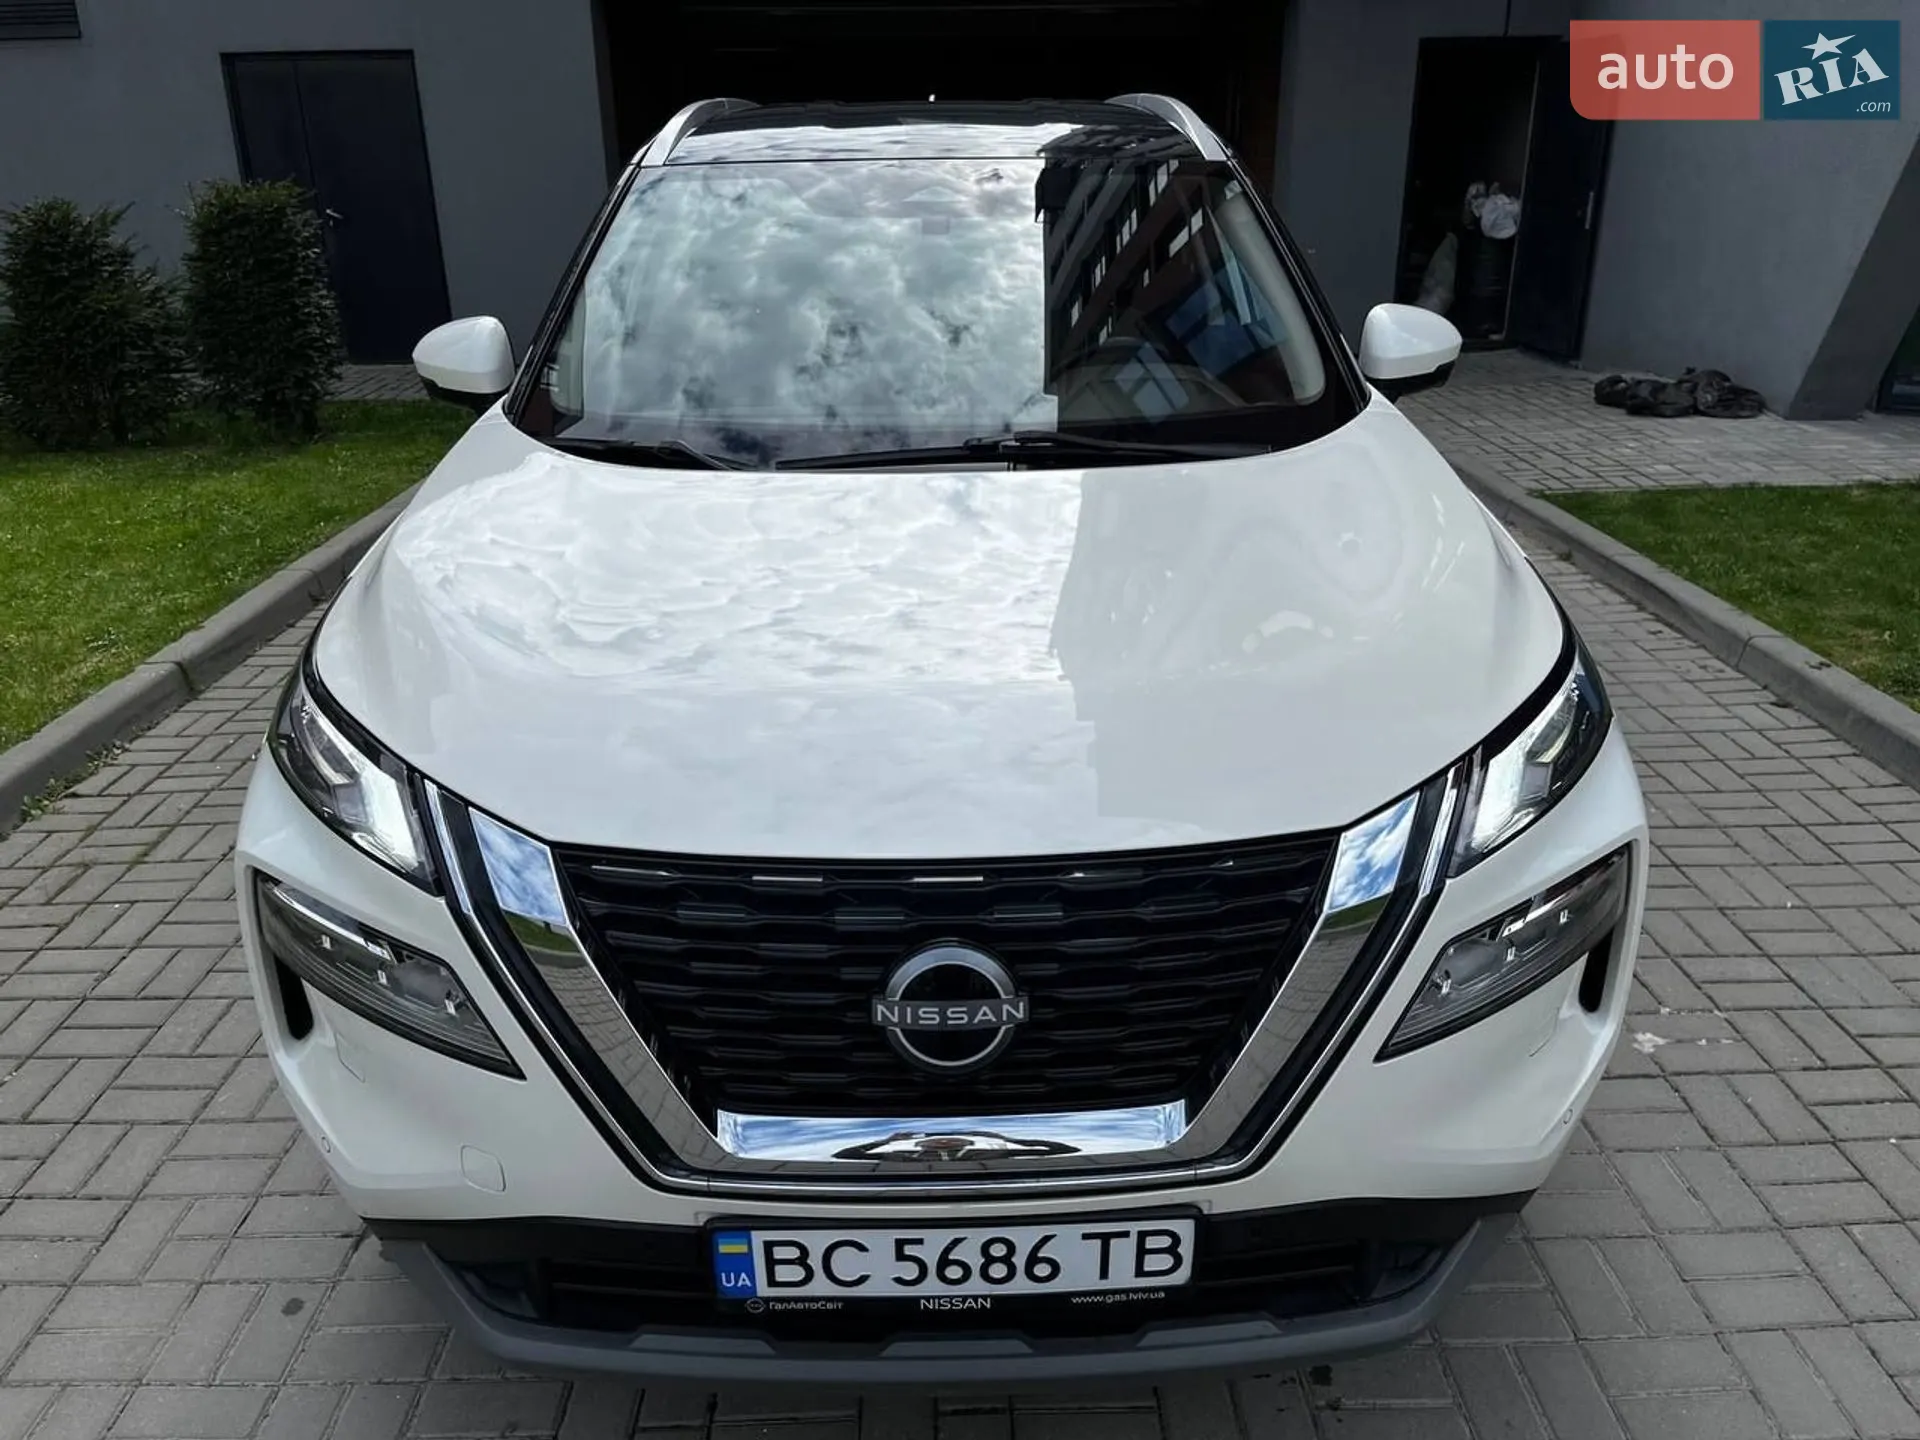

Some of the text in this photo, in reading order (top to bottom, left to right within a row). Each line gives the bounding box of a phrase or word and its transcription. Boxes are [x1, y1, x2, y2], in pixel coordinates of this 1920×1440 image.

[877, 1002, 1024, 1025] NISSAN
[762, 1229, 1184, 1288] BC 5686 TB
[721, 1272, 752, 1288] UA
[920, 1297, 992, 1310] NISSAN
[1070, 1290, 1166, 1304] www.gas.lviv.ua
